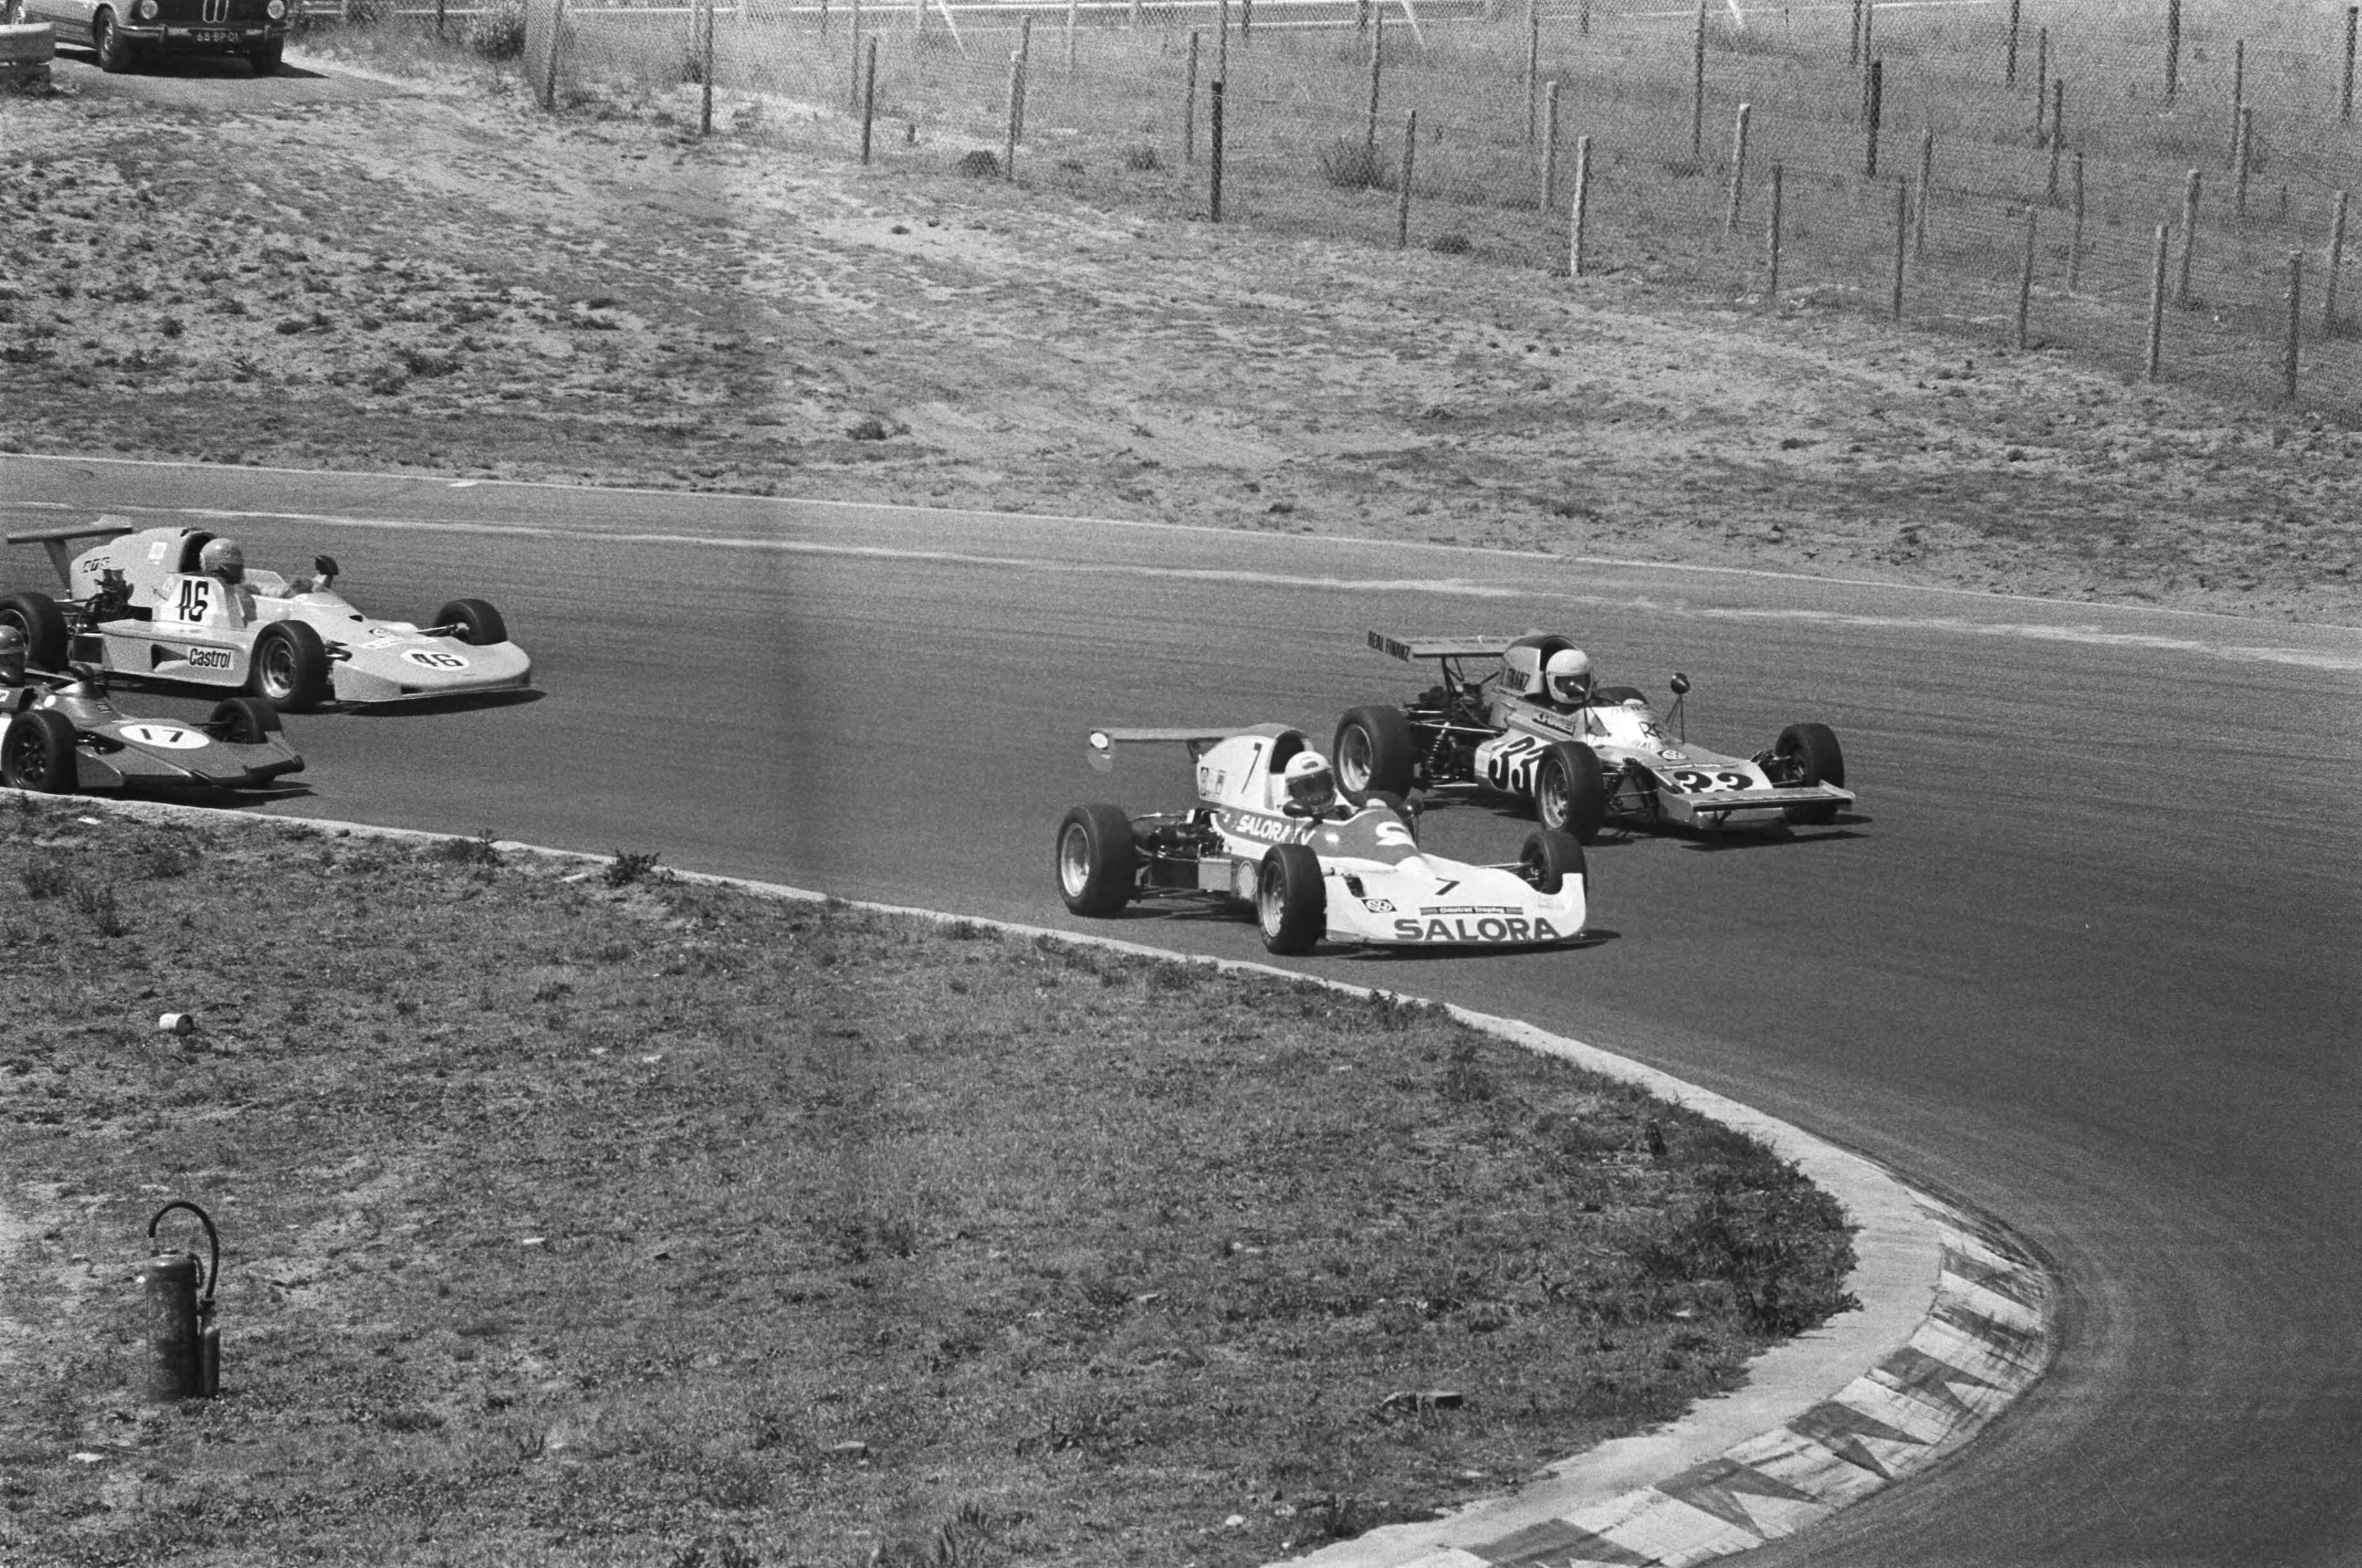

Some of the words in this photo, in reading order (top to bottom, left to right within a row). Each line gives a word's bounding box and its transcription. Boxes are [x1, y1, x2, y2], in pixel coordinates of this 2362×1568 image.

[176, 580, 209, 622] 46
[189, 647, 232, 669] Castrol
[411, 652, 464, 667] 46
[140, 729, 184, 743] 17
[1241, 742, 1262, 794] 7
[1236, 814, 1291, 842] SALORA
[1435, 877, 1460, 895] 7
[1394, 918, 1561, 942] SALORA
